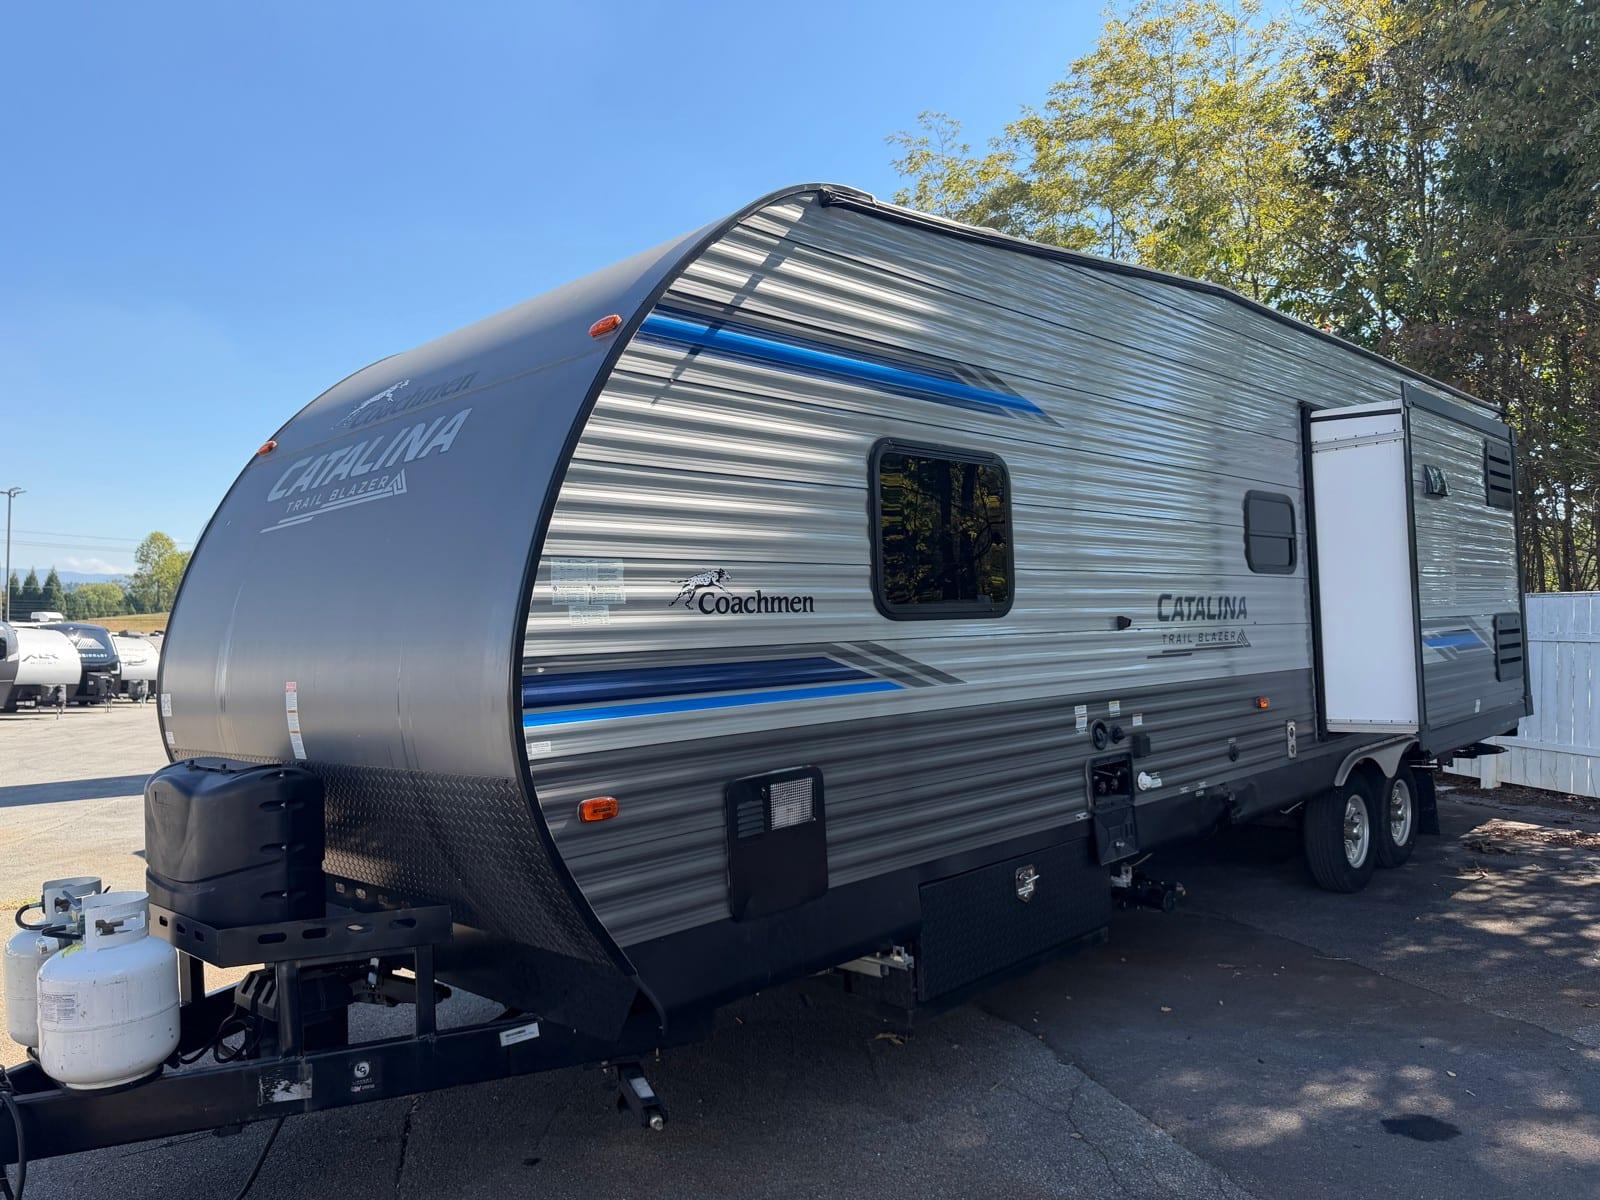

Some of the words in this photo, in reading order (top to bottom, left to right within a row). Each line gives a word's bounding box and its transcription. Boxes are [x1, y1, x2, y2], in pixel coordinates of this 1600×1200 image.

[267, 408, 473, 502] CATALINA
[286, 493, 322, 512] TRAIL
[329, 475, 388, 501] BLAZER
[698, 589, 815, 615] Coachmen
[1157, 593, 1248, 622] CATALINA
[1162, 633, 1193, 645] TRAIL
[1198, 630, 1236, 643] BLAZER
